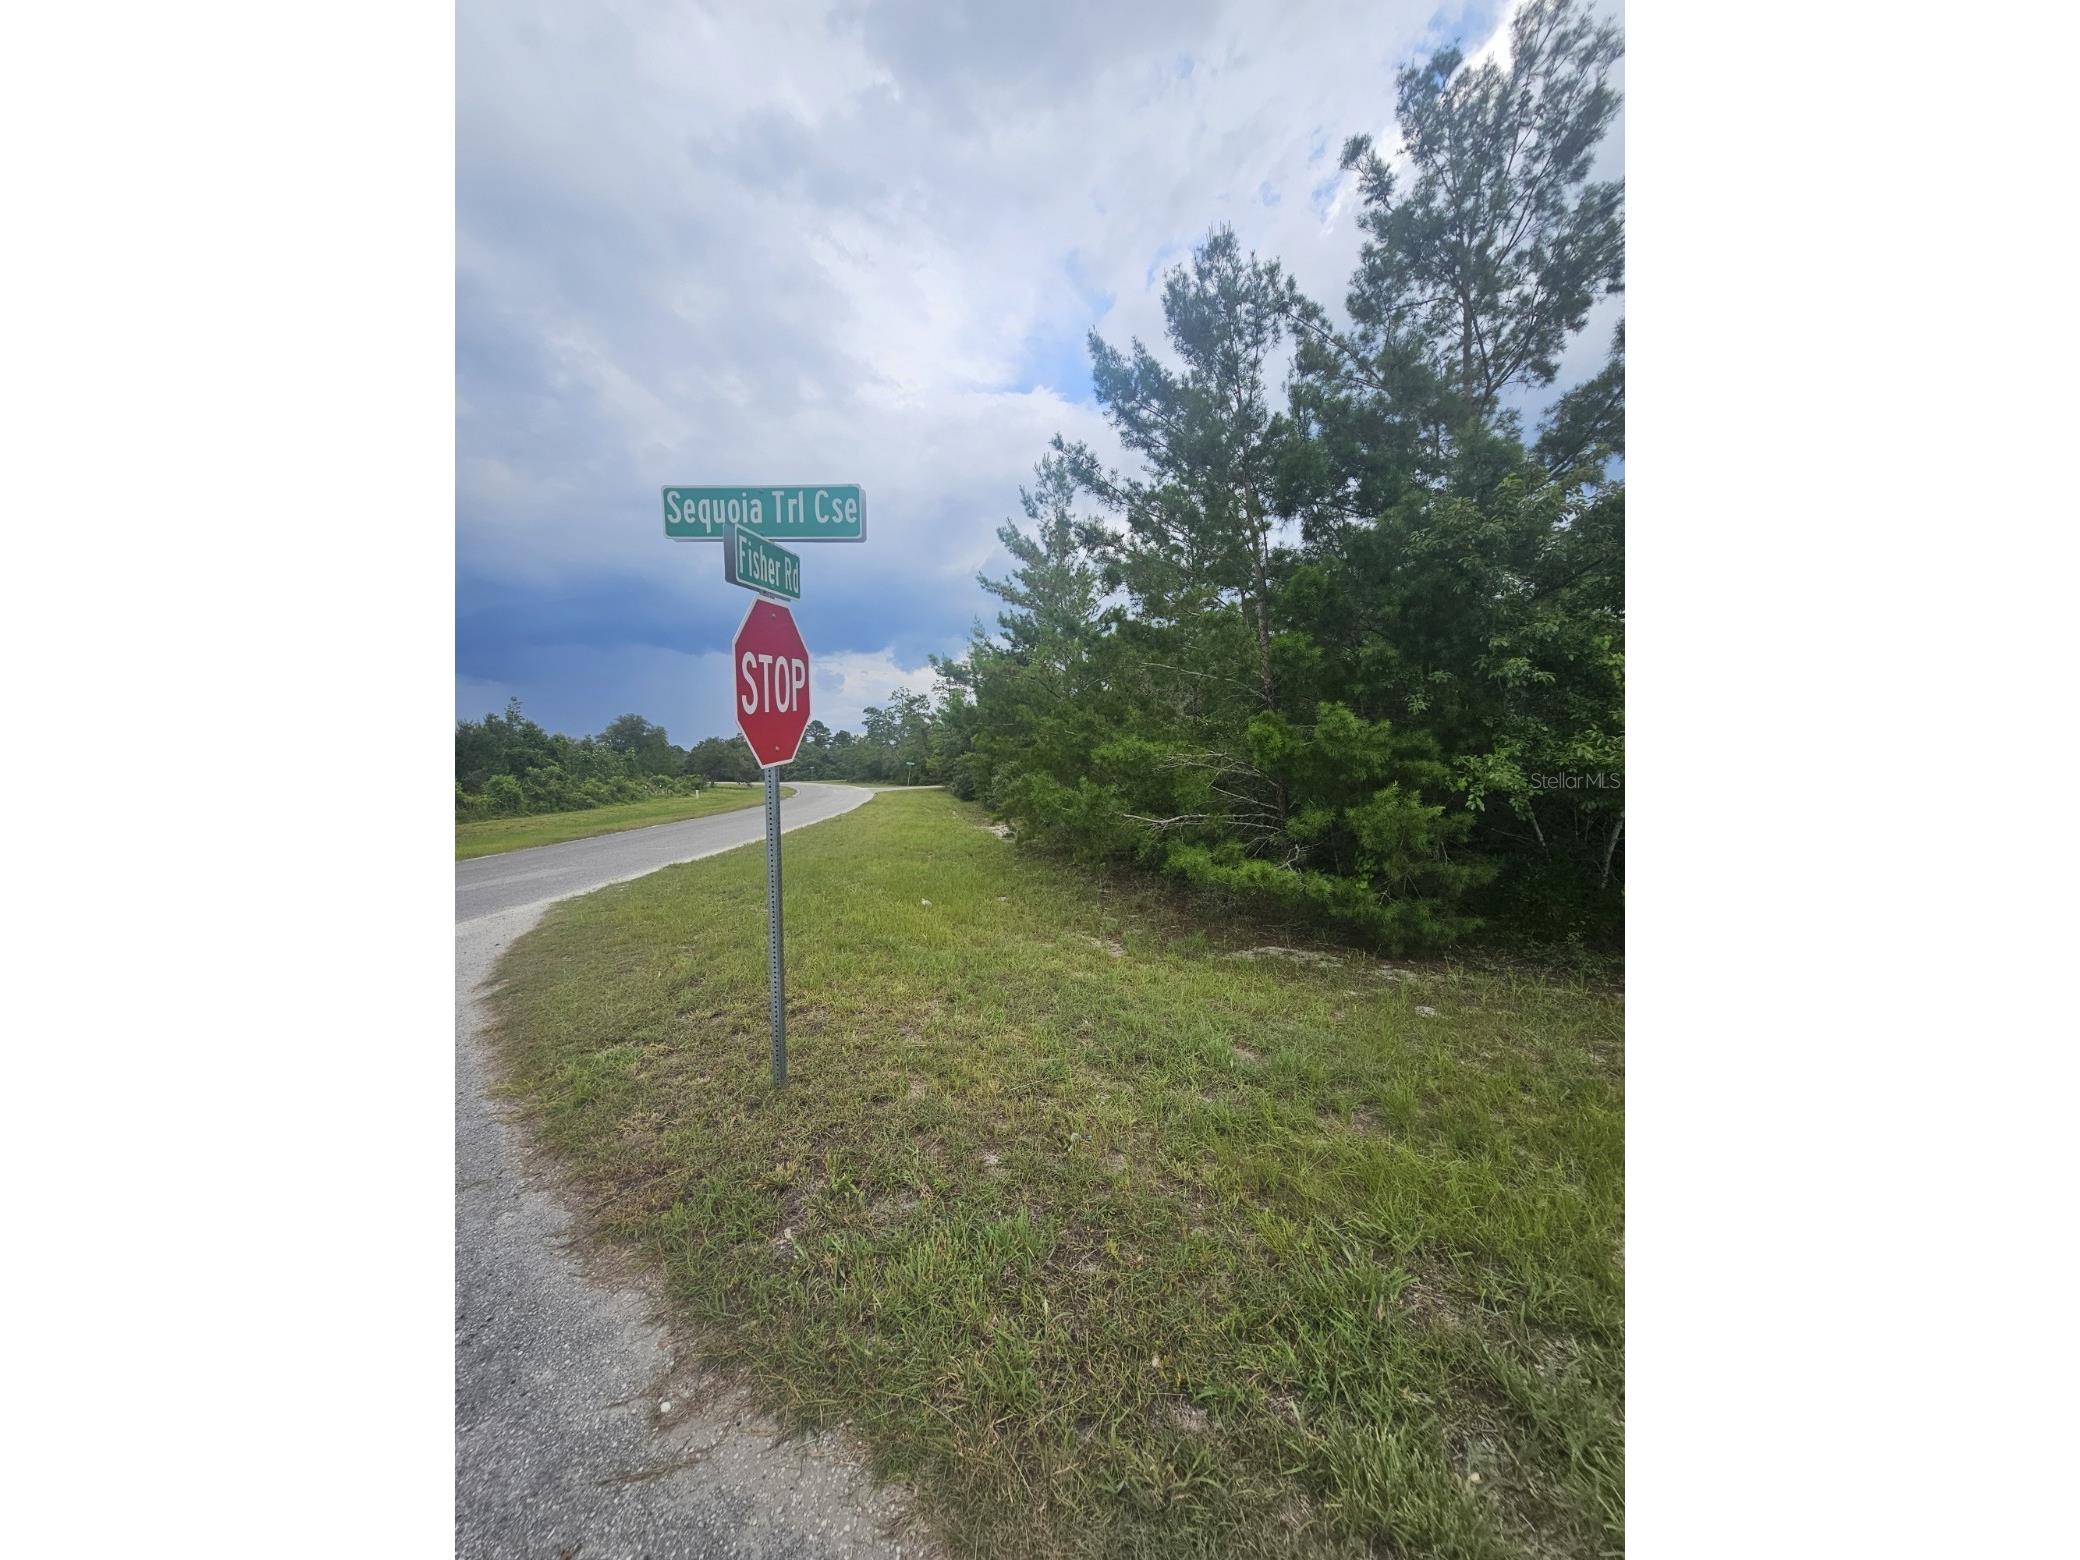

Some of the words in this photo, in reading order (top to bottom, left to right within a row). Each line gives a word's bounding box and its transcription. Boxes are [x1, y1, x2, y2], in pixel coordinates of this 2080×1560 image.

[666, 490, 762, 533] Sequoia
[771, 490, 804, 523] Trl
[814, 489, 857, 523] Cse
[738, 535, 781, 588] Fisher
[785, 556, 800, 593] Rd
[741, 651, 805, 715] STOP
